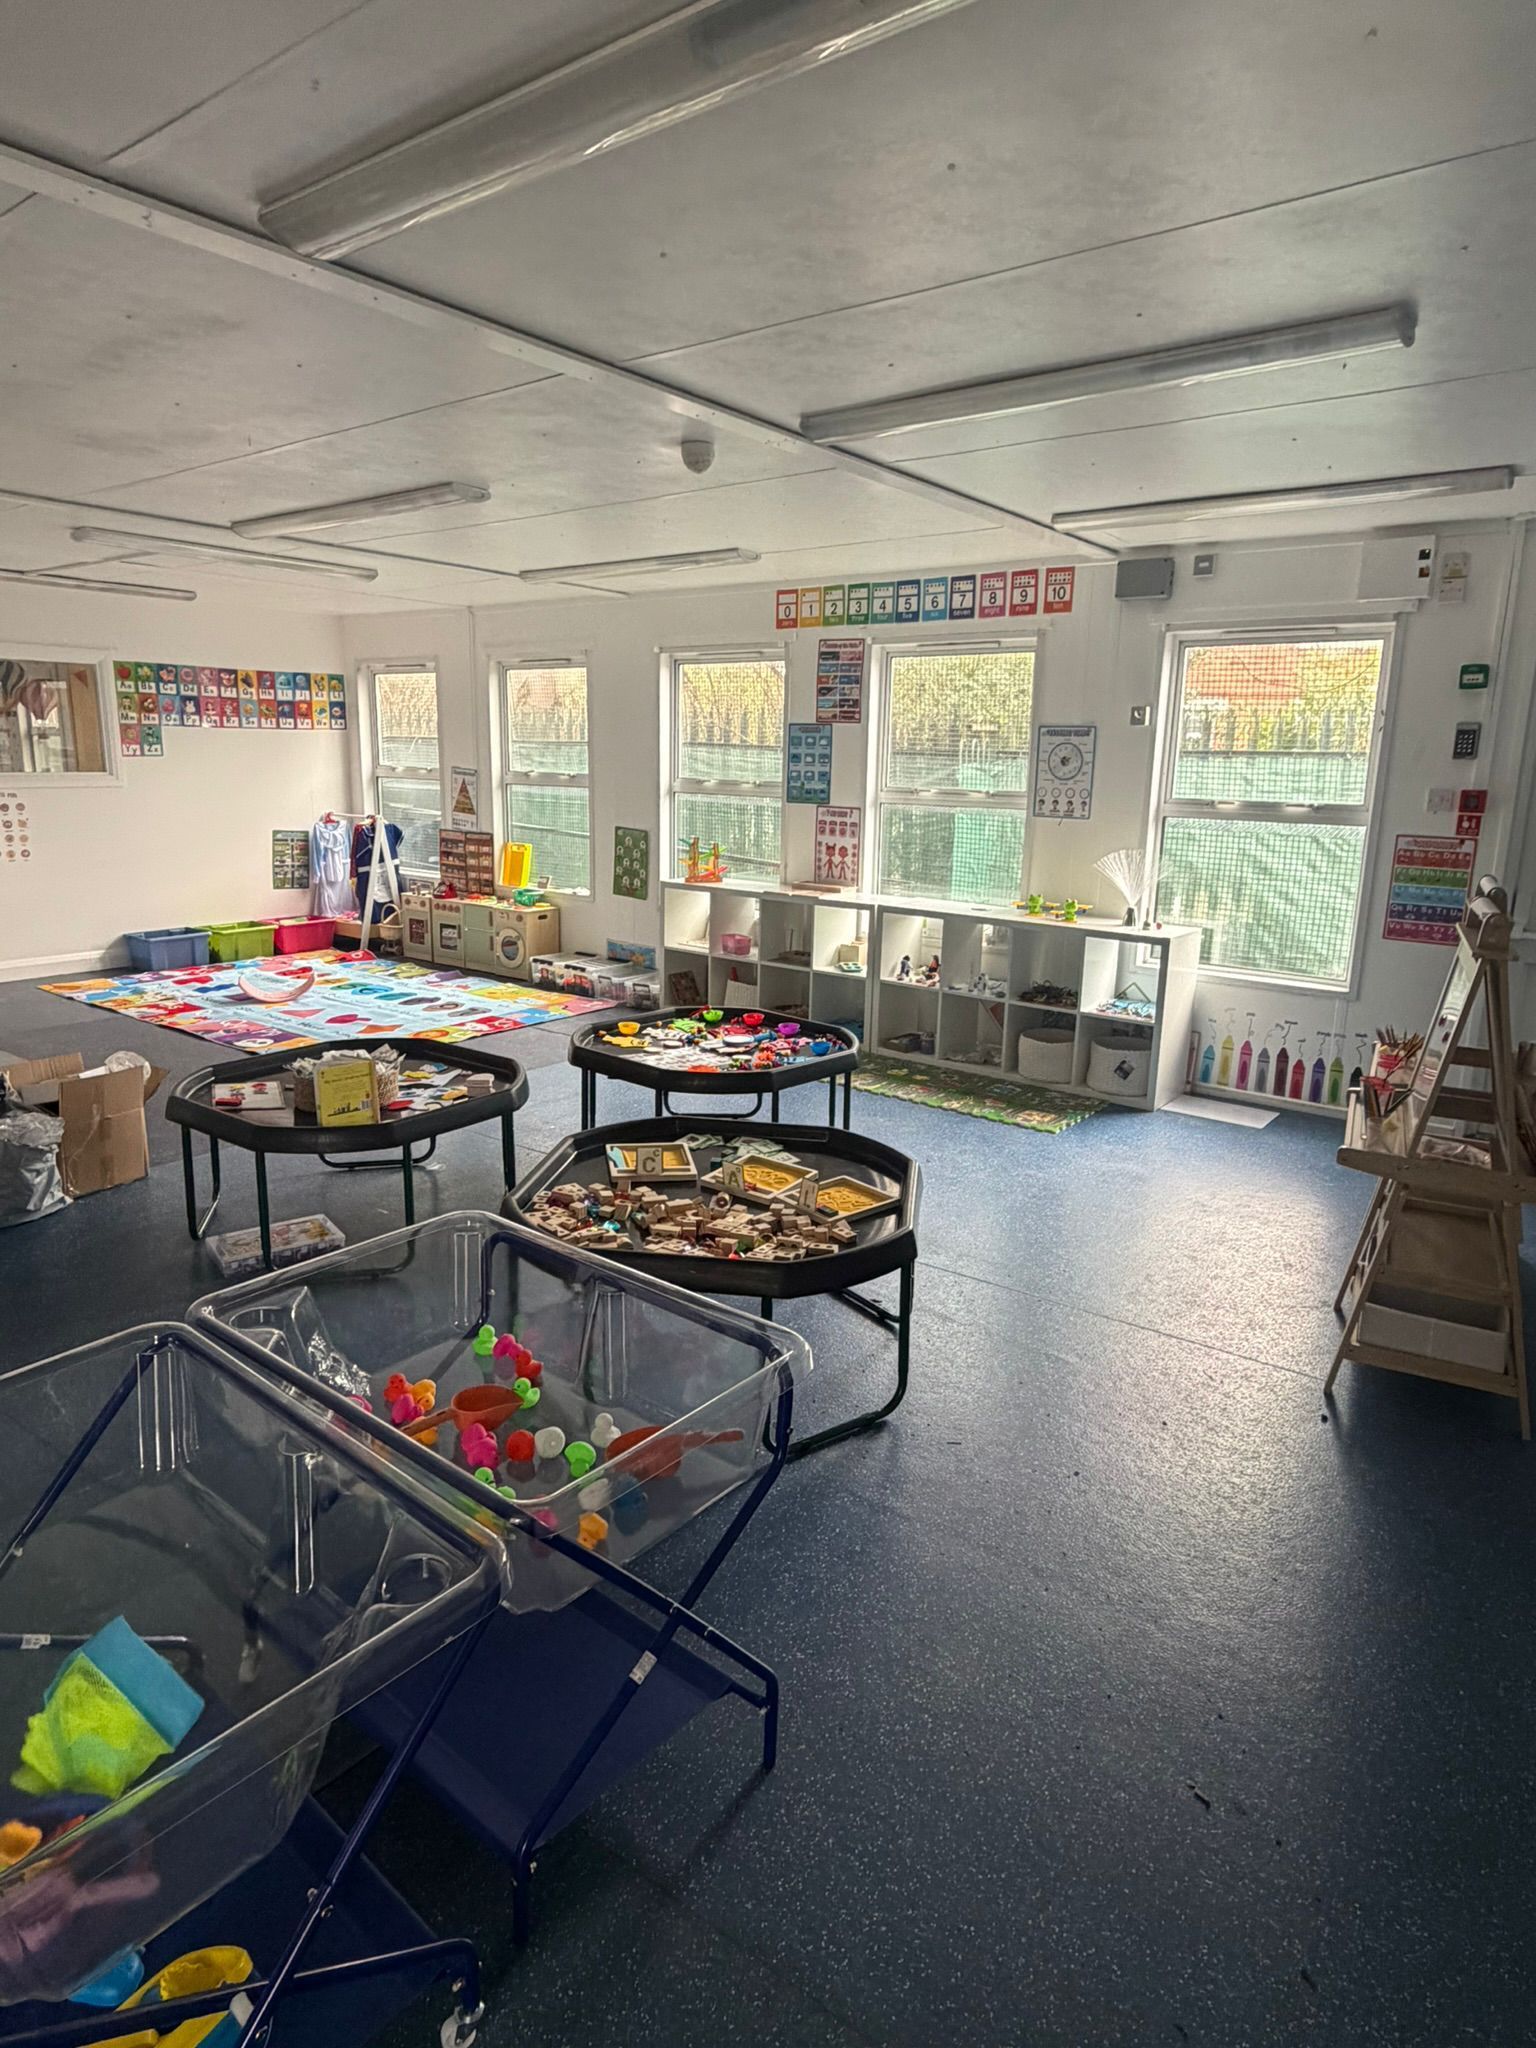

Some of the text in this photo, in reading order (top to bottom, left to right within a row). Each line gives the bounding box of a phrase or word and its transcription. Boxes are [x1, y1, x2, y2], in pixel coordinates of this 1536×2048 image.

[988, 592, 997, 604] 8
[1020, 589, 1028, 602] 9
[1052, 586, 1066, 600] 10
[880, 600, 886, 612] 4
[904, 598, 912, 610] 5
[931, 596, 938, 608] 6
[960, 594, 966, 606] 7
[784, 606, 791, 617] 0
[808, 604, 814, 616] 1
[830, 602, 838, 614] 2
[855, 601, 862, 613] 3
[642, 1156, 656, 1173] C
[728, 1173, 740, 1190] A
